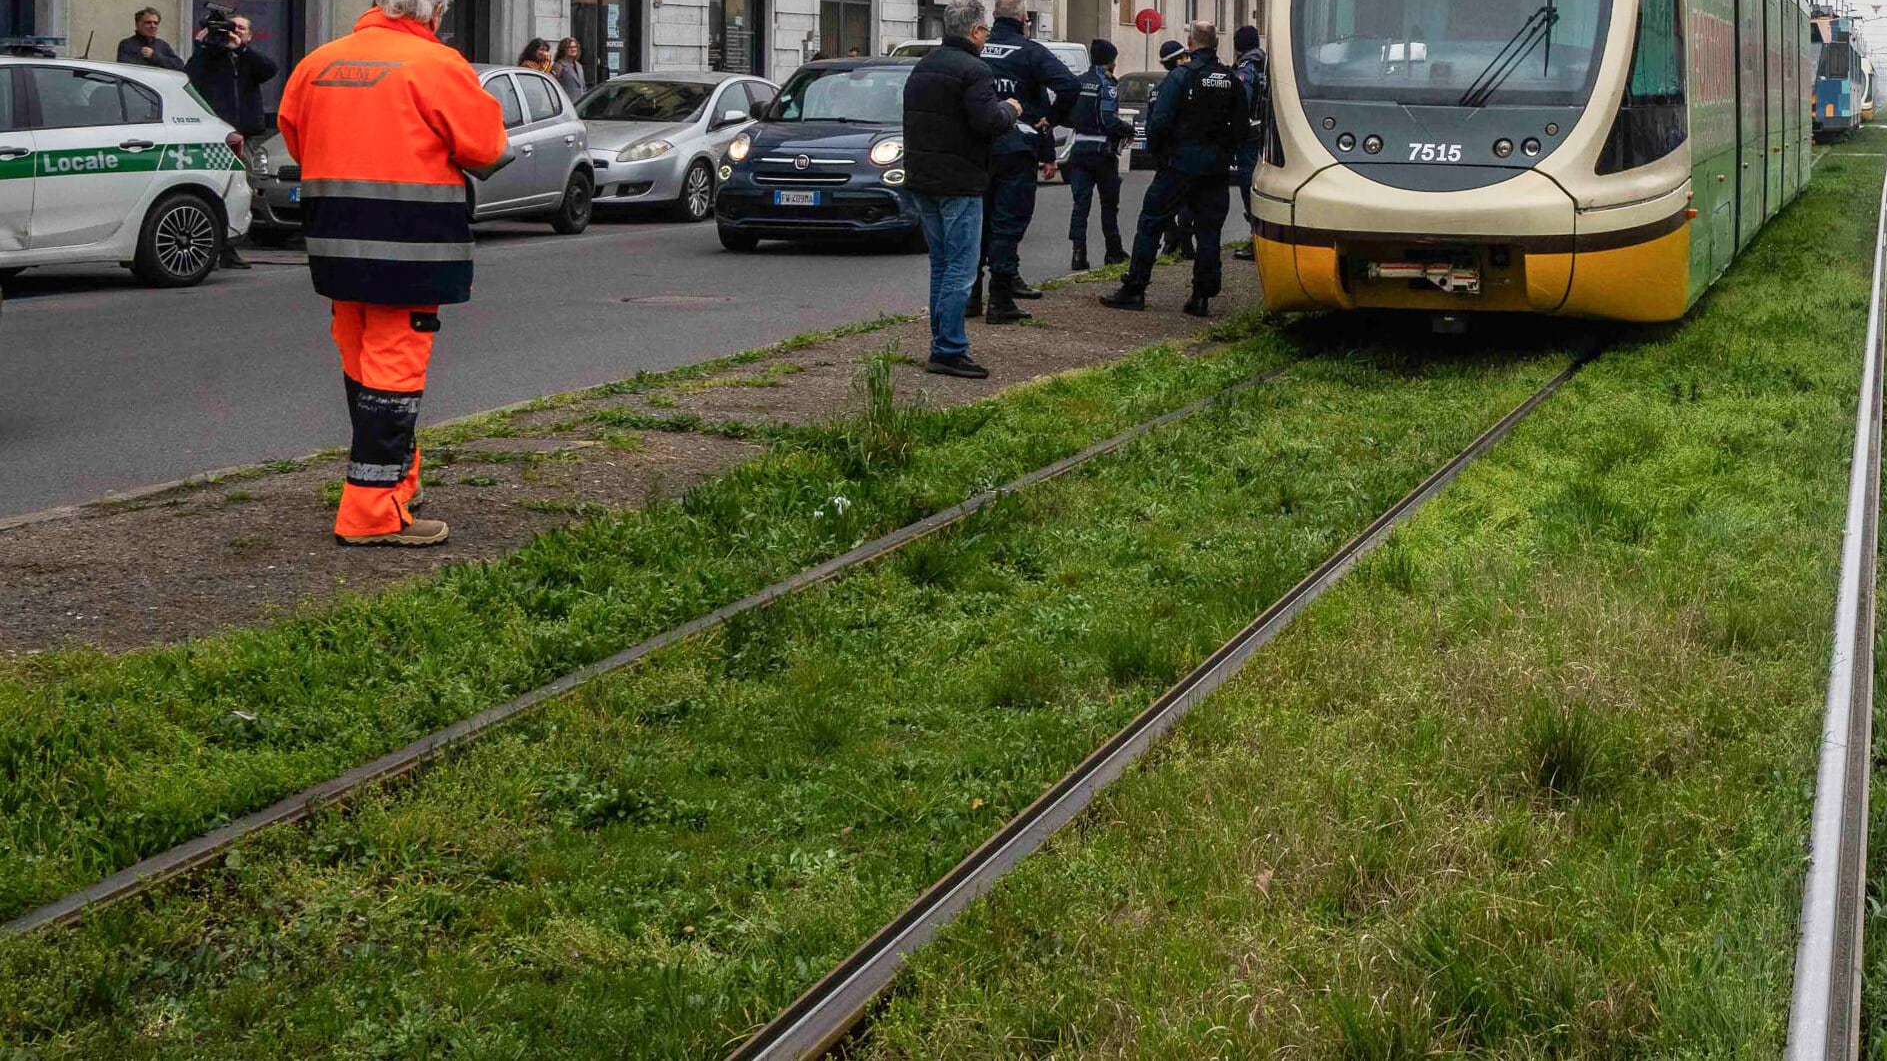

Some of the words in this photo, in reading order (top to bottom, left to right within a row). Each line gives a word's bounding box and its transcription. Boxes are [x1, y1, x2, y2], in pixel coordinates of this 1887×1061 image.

[1202, 78, 1231, 88] SECURITY
[44, 151, 119, 173] Locale
[1409, 142, 1462, 162] 7515
